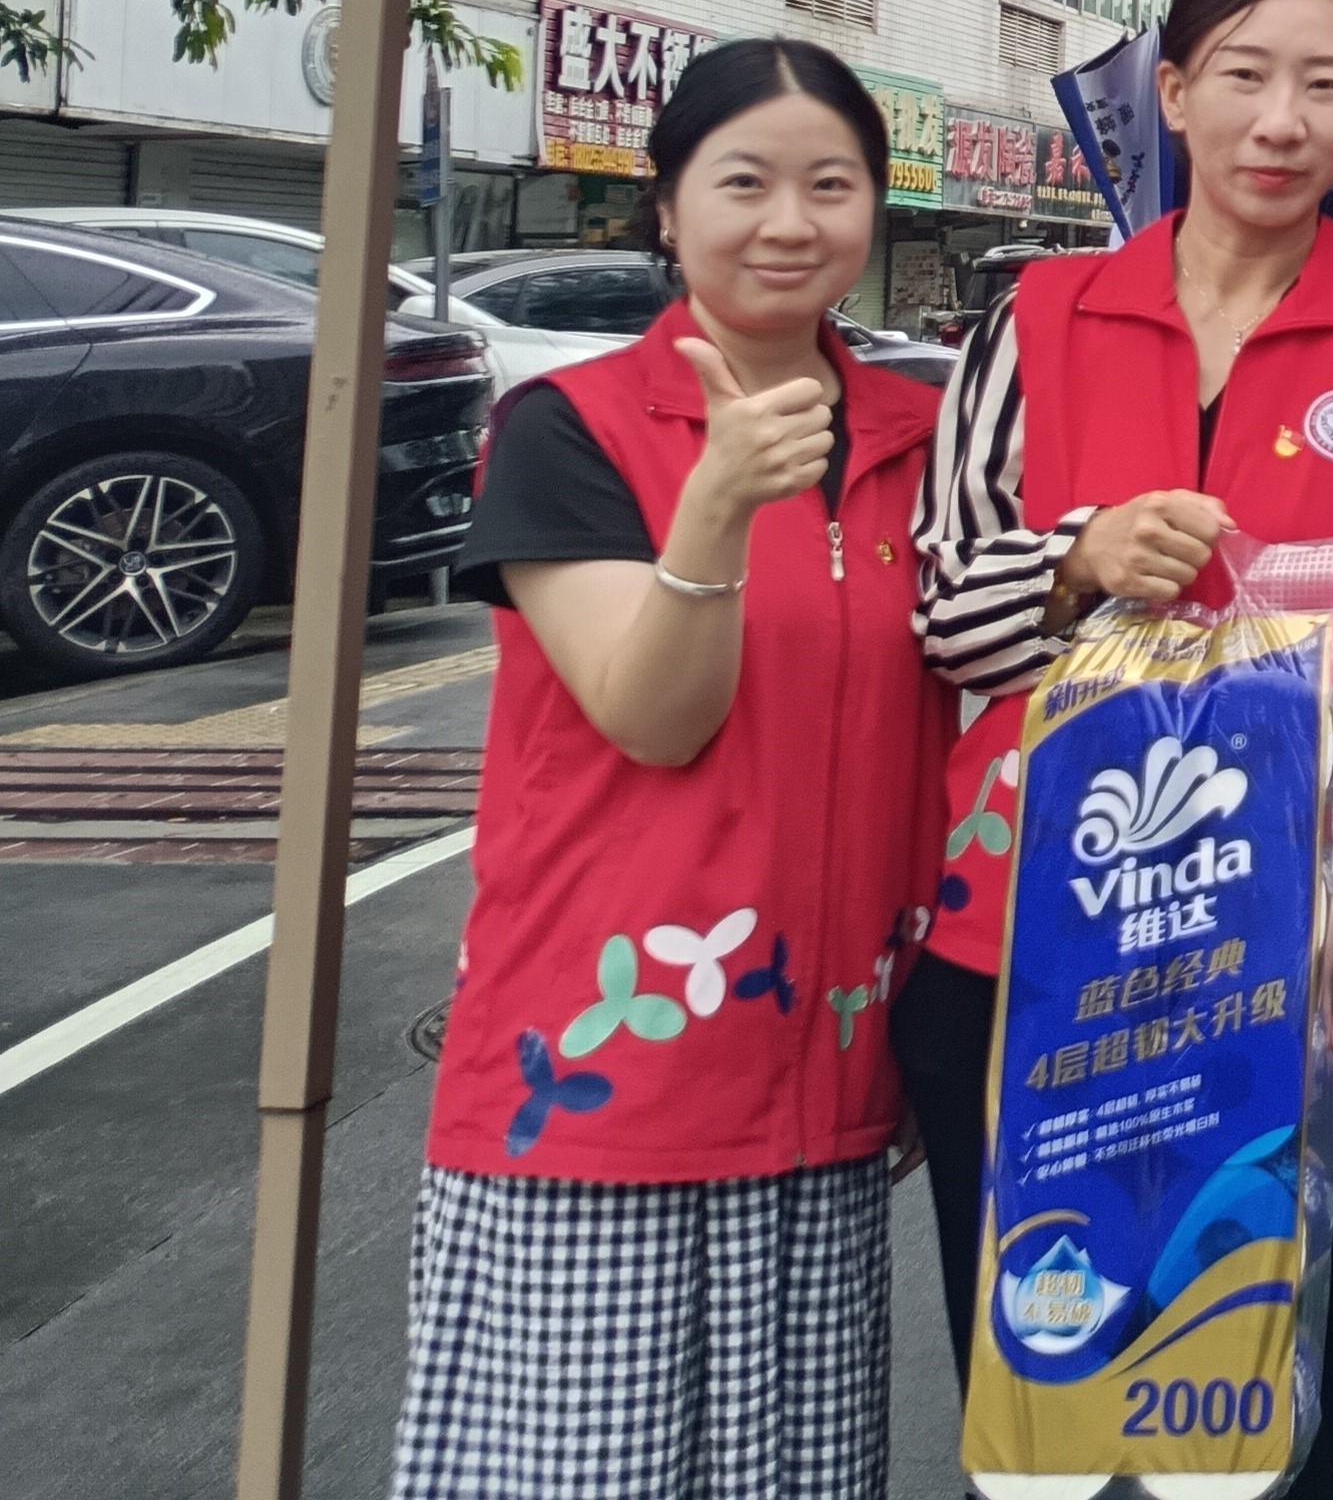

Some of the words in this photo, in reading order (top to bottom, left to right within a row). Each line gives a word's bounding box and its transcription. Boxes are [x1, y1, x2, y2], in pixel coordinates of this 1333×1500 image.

[558, 5, 717, 106] 盛大不锈
[1069, 837, 1253, 918] Vinda
[1119, 893, 1218, 953] 维达
[1075, 938, 1247, 1024] 蓝色经典
[1025, 977, 1288, 1091] 4层超韧大升级
[1023, 1301, 1095, 1325] 不易破
[1036, 1271, 1084, 1297] 超韧
[1122, 1377, 1274, 1438] 2000
